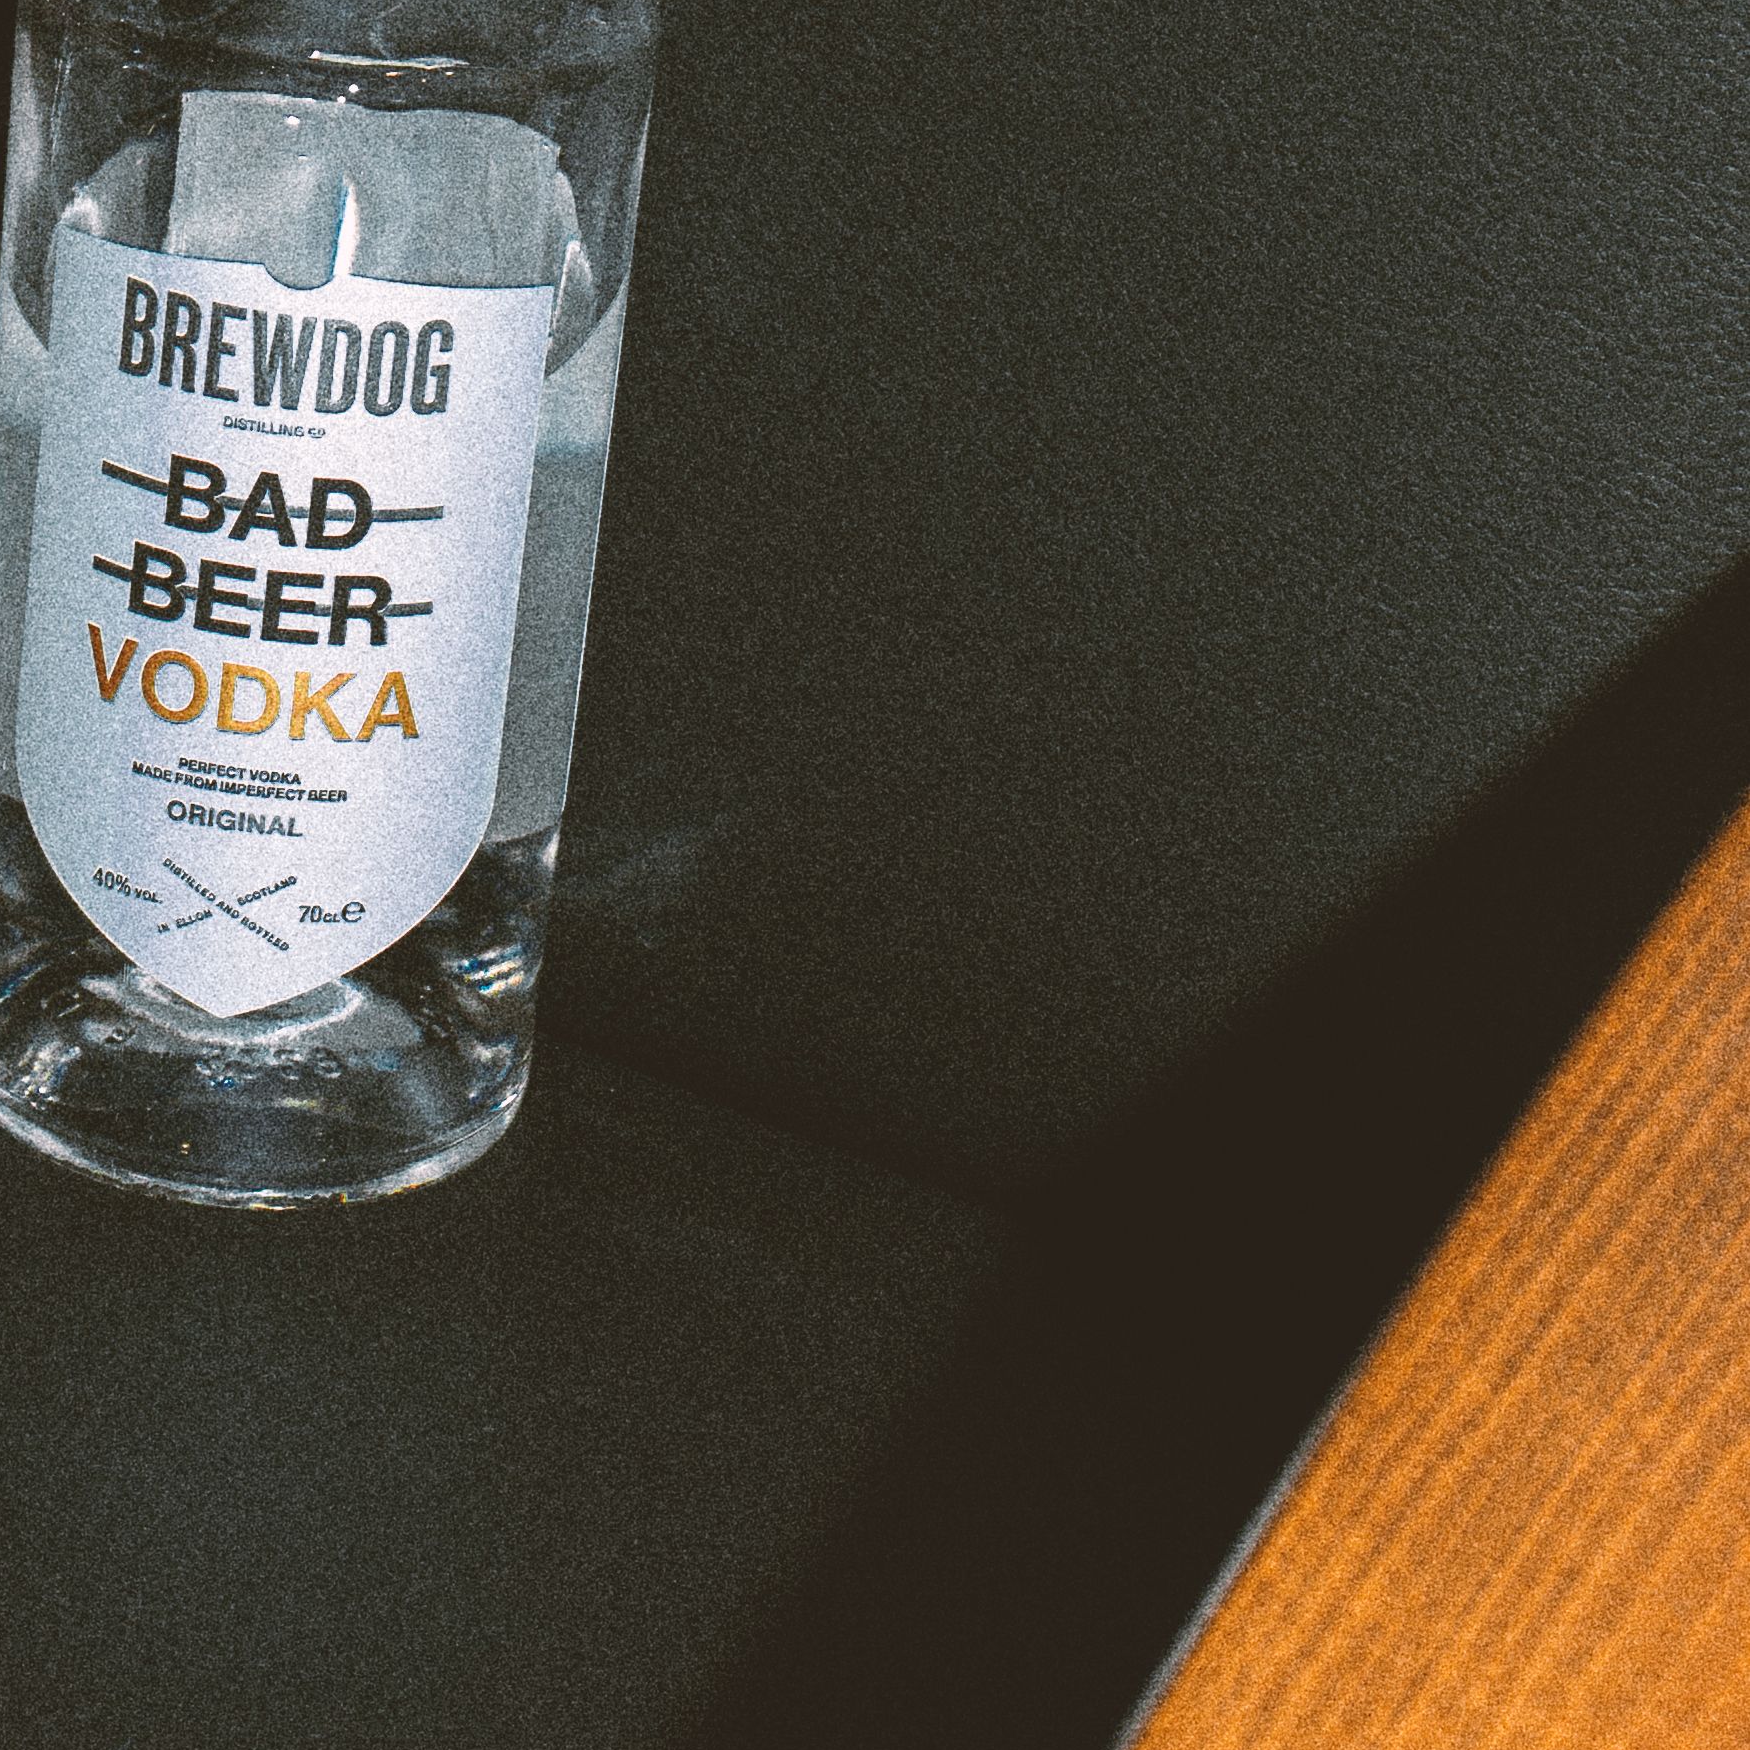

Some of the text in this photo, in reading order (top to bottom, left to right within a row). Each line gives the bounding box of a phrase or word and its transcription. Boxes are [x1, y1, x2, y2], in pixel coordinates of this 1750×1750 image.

[118, 275, 454, 417] BREWDOG
[222, 415, 305, 437] DISTILLING
[164, 453, 373, 550] BAD
[128, 540, 392, 646] BEER
[88, 621, 419, 742] VODKA
[131, 760, 348, 802] MADE FROM IMPERFECT BEER
[178, 757, 301, 785] PERFECT VODKA
[166, 799, 303, 838] ORIGINAL
[162, 857, 290, 951] DISTILLED AND BOTTLED
[237, 875, 297, 906] SCOTLAND
